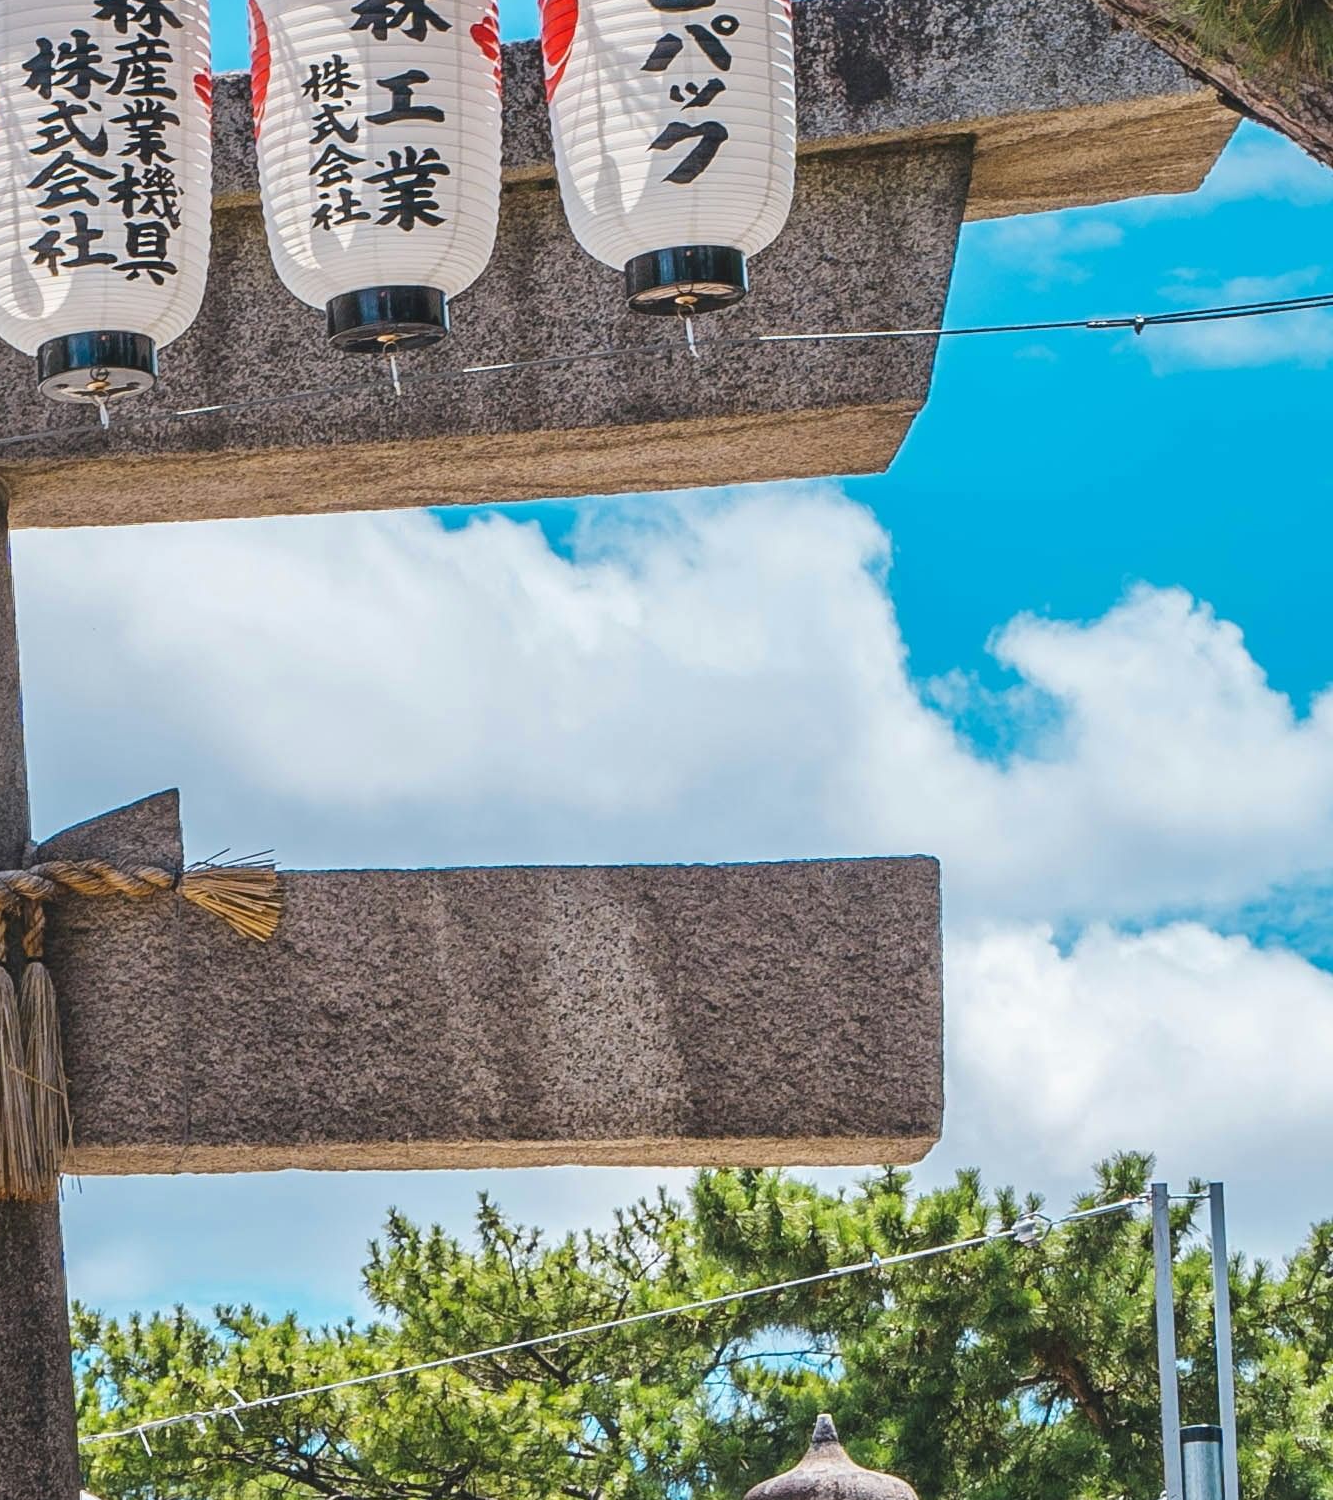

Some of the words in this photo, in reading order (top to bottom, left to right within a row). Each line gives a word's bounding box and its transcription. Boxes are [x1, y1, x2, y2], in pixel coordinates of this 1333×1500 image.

[23, 29, 118, 277] 株式会社
[301, 54, 371, 231] 株式会社
